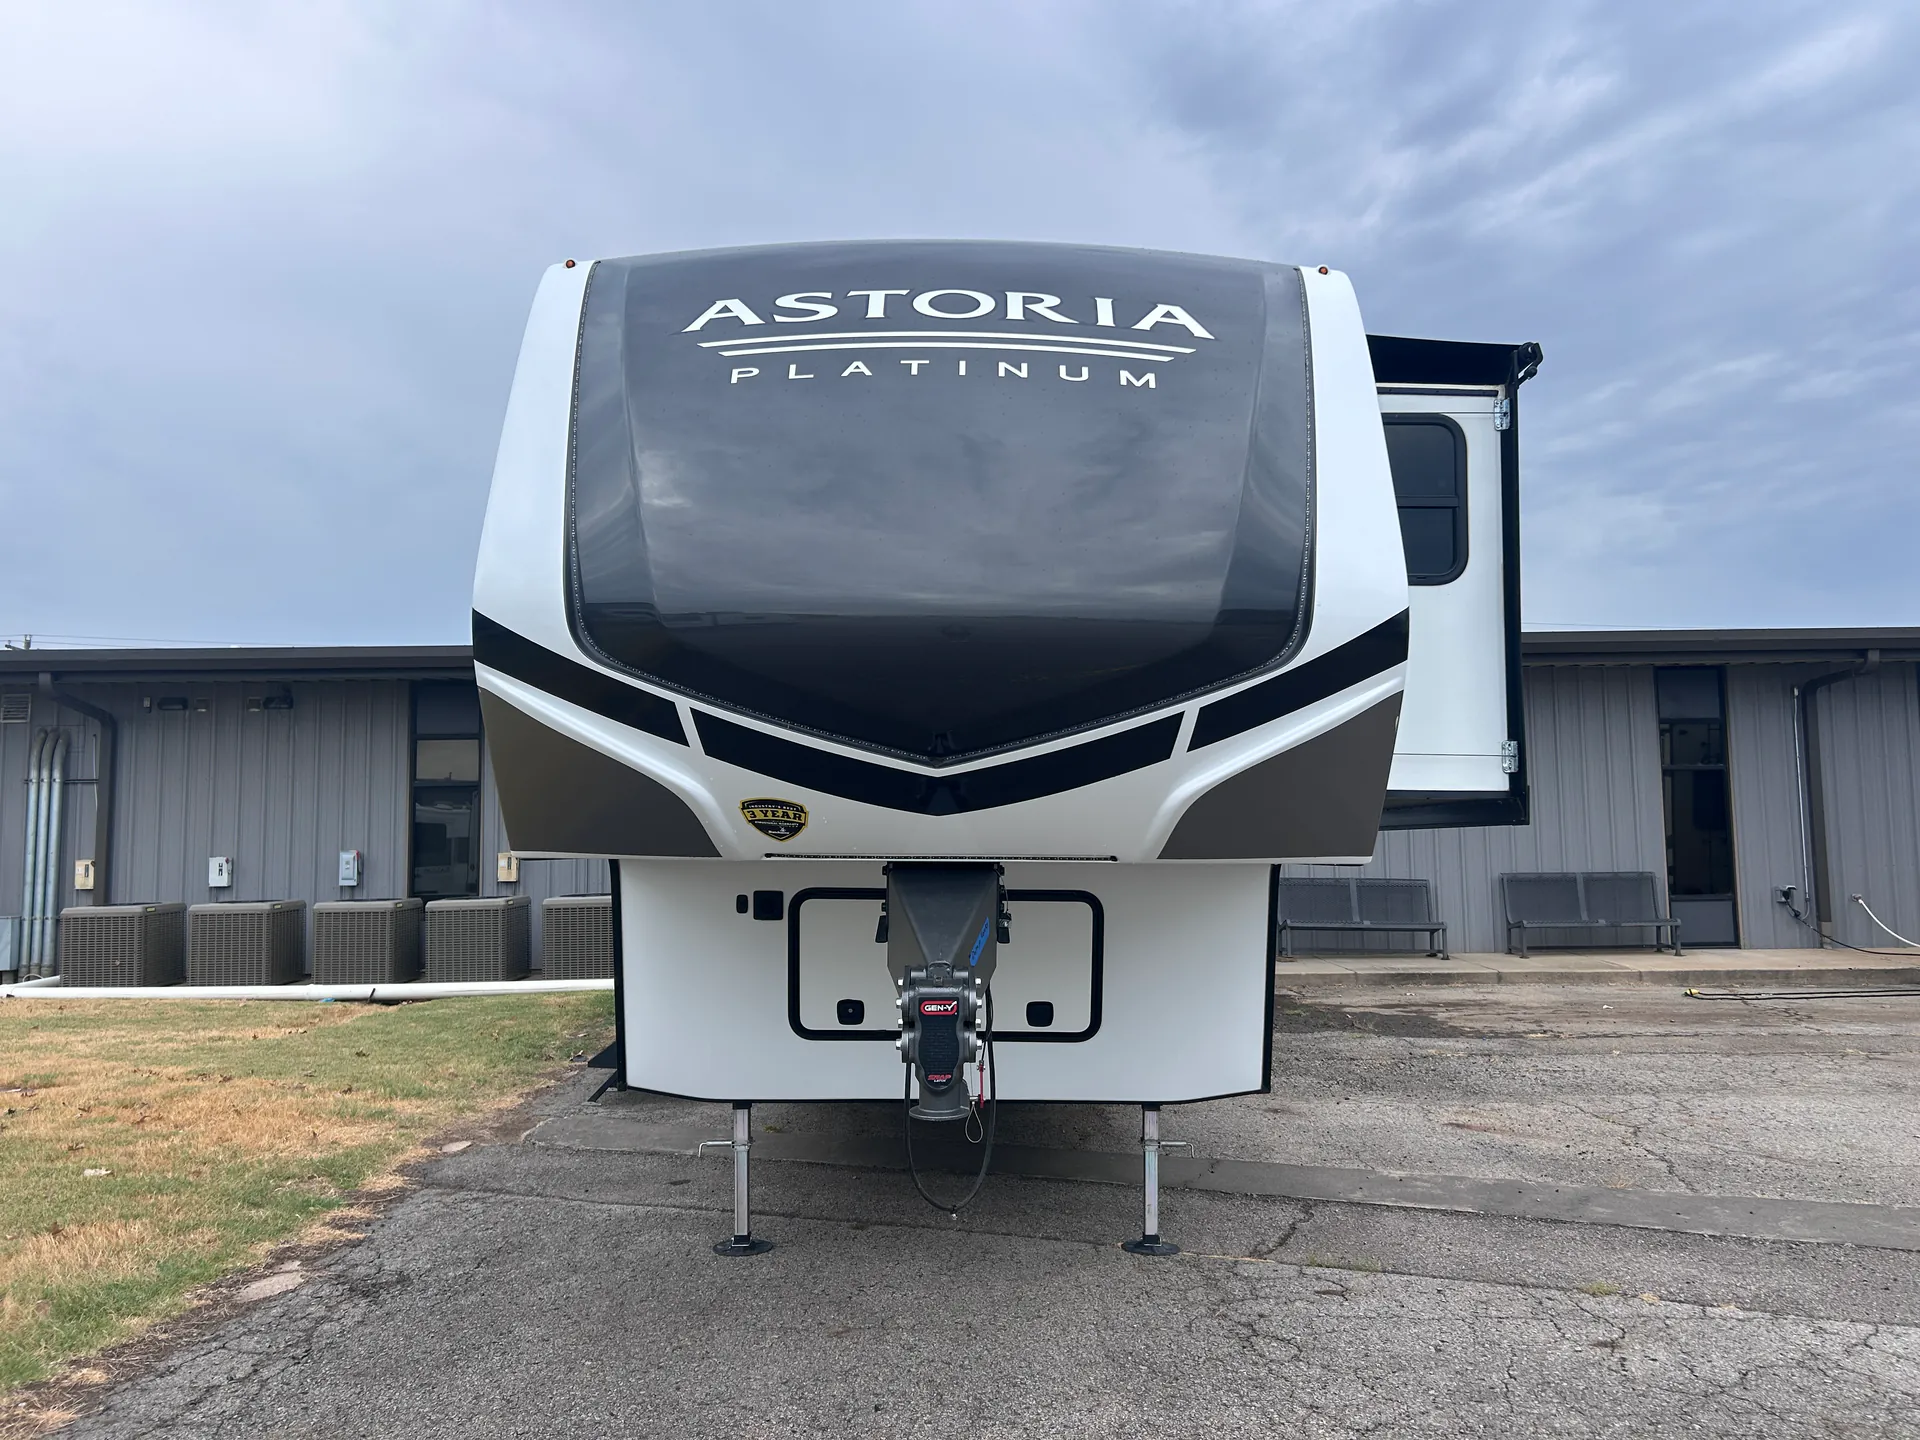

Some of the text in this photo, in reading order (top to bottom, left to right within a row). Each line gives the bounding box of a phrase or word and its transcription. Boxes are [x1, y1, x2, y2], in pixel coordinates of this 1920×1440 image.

[681, 289, 1215, 340] ASTORIA
[730, 360, 1156, 389] PLATINUM
[747, 810, 803, 821] 3 YEAR
[924, 1001, 957, 1012] GEN-Y
